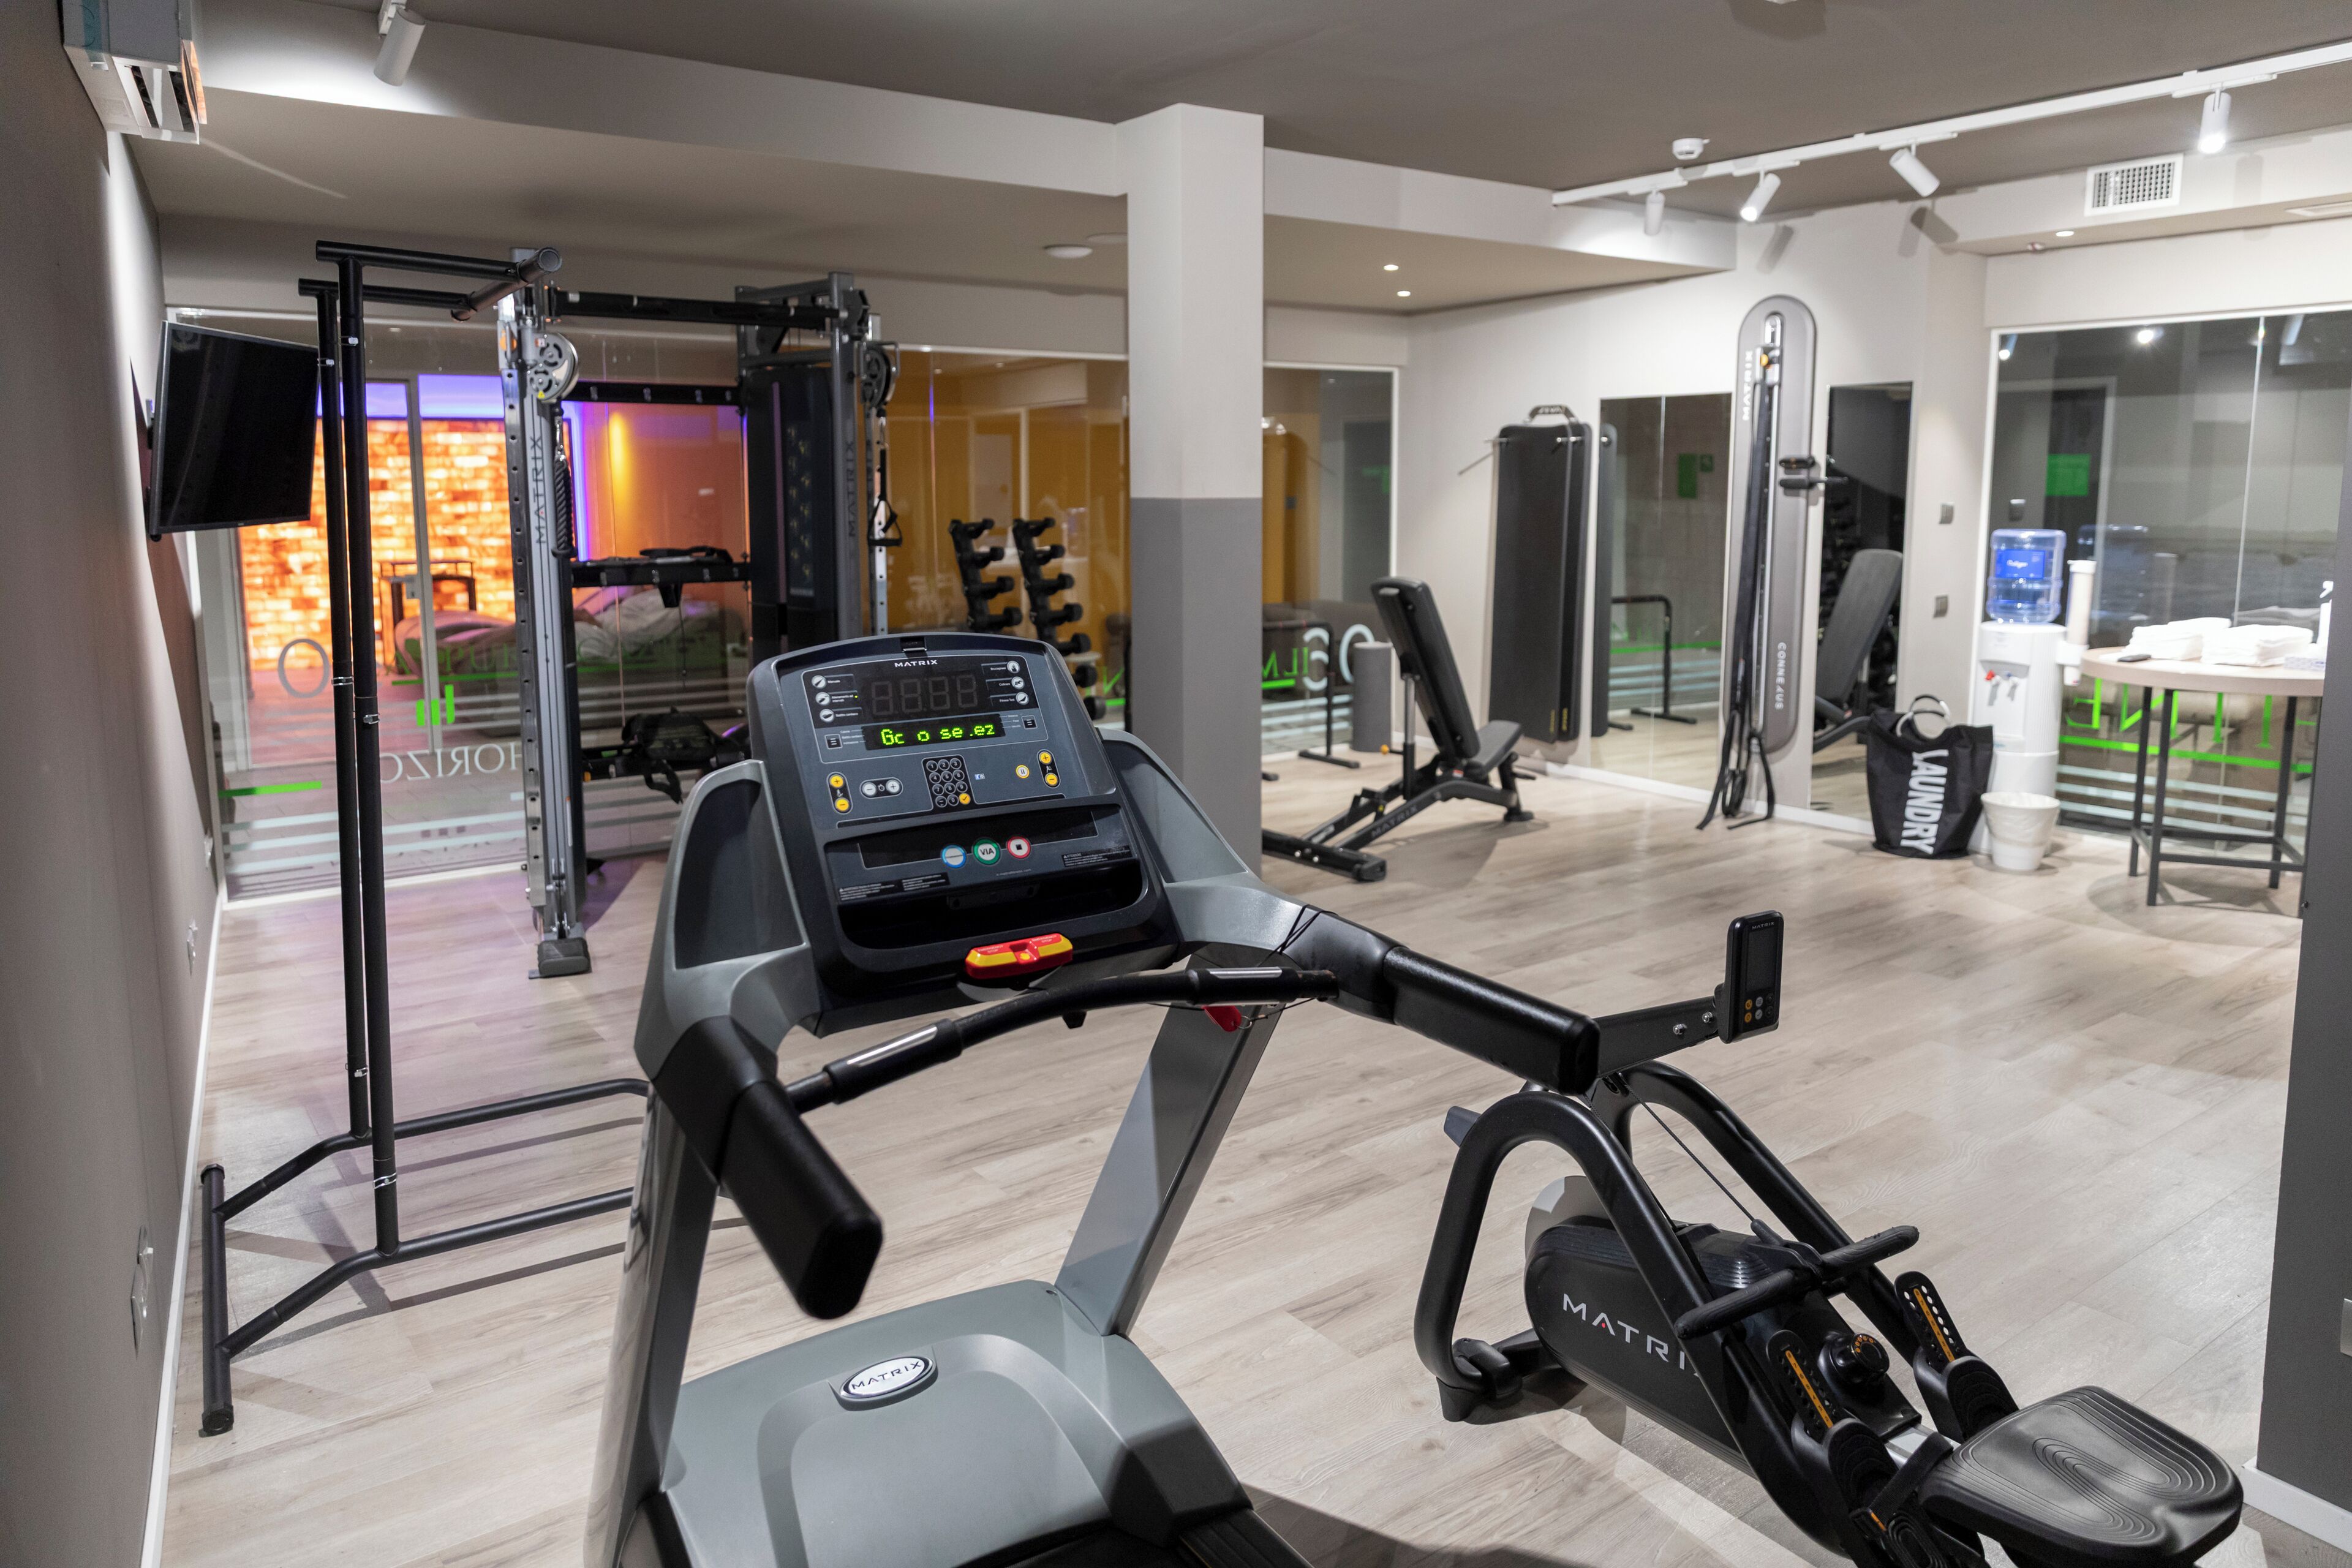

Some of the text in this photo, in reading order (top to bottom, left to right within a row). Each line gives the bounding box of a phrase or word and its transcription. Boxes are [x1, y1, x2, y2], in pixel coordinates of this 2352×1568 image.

[1742, 350, 1753, 421] MATRIX
[529, 435, 547, 543] MATRIX
[846, 440, 856, 537] MATRIX
[1900, 748, 1950, 855] LAUNDRY
[1752, 921, 1774, 930] MATRIX
[851, 1361, 921, 1390] MATRIX
[1563, 1293, 1700, 1378] MATRI
